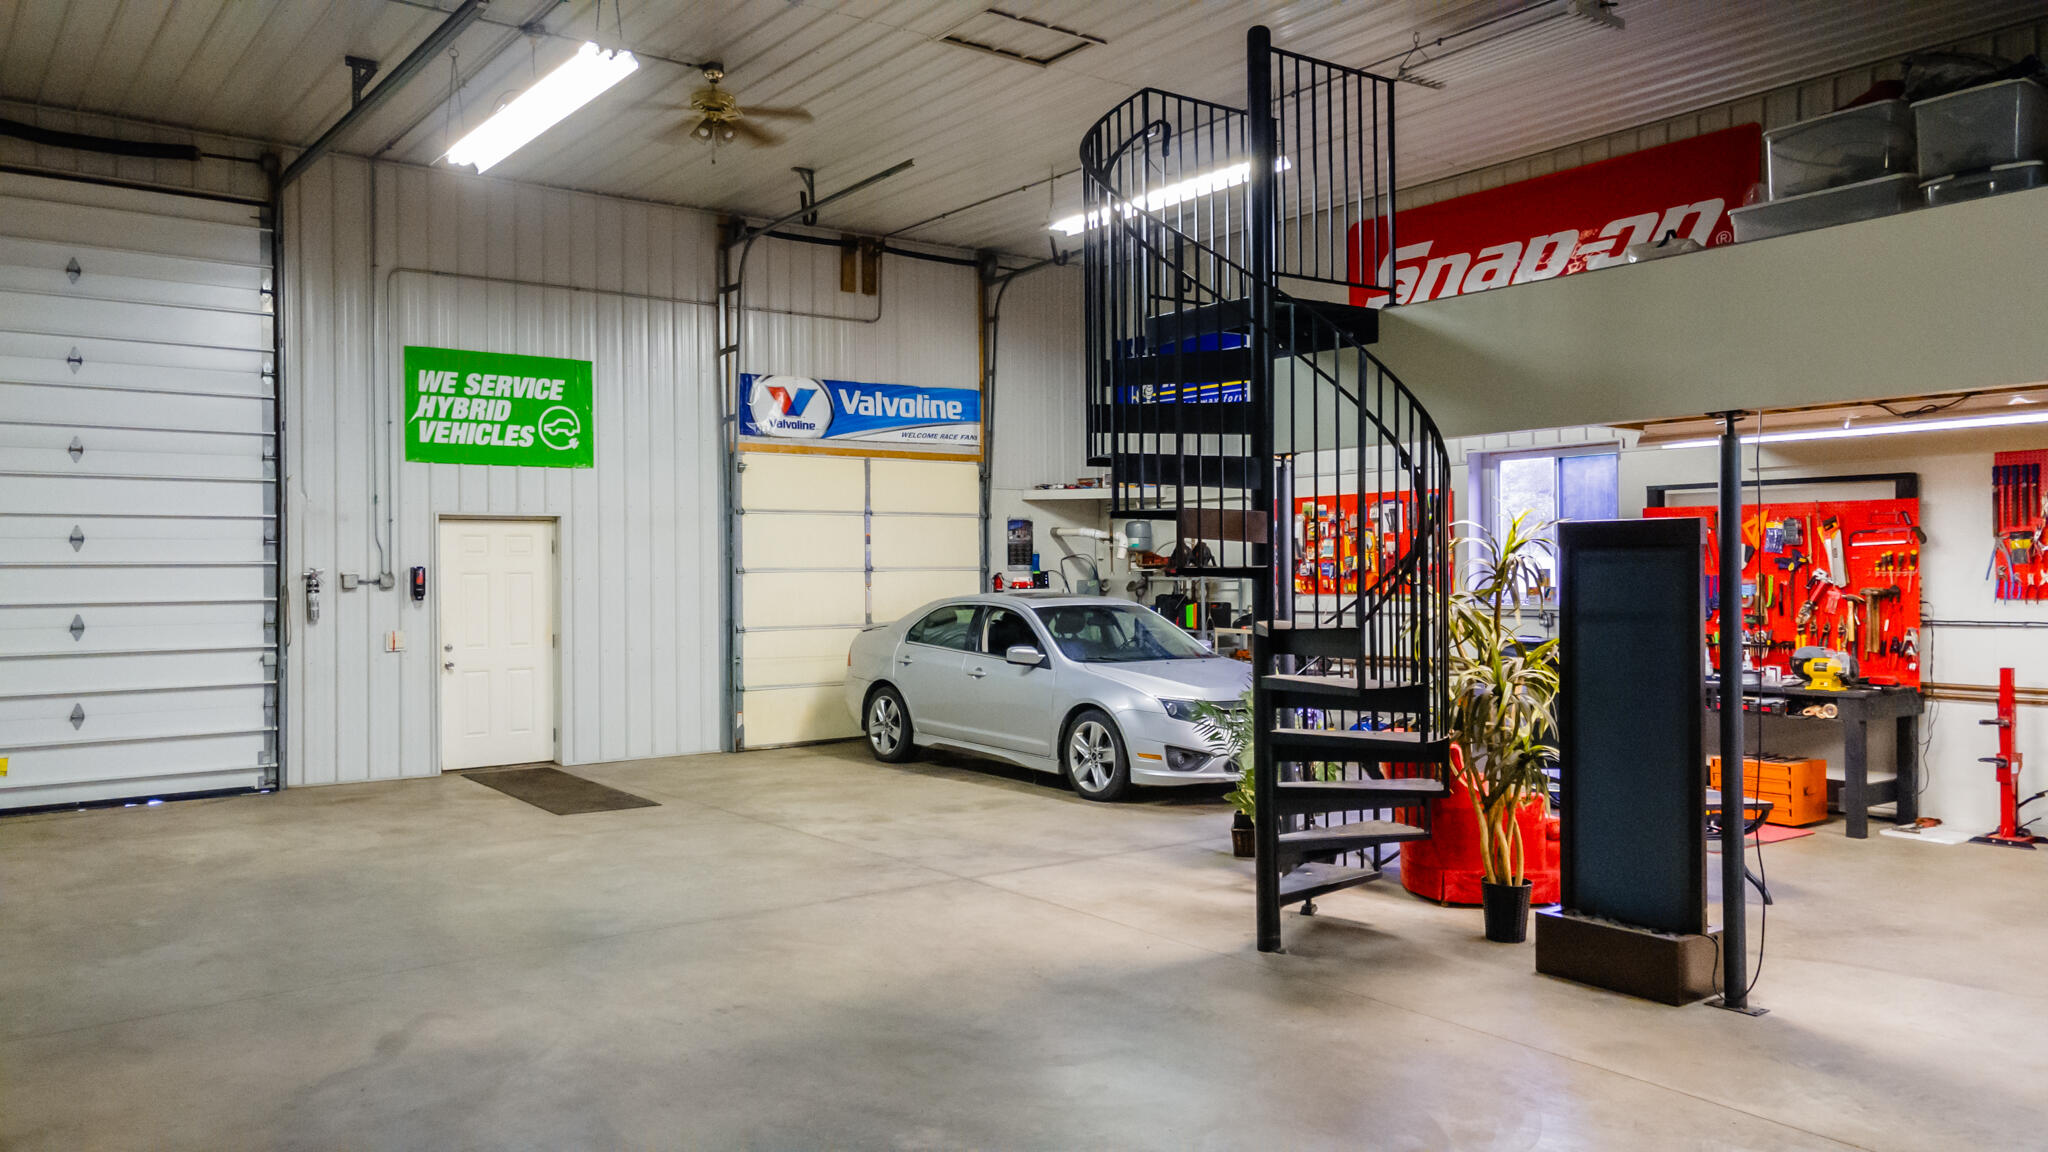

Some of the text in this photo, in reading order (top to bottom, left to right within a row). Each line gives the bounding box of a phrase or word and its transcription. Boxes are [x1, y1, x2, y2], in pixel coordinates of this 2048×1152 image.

[1366, 198, 1725, 310] Snap-on
[418, 369, 566, 401] WE SERVICE
[408, 395, 512, 423] HYBRID
[838, 388, 963, 419] Valvoline
[418, 420, 536, 448] VEHICLES
[768, 418, 816, 431] Valvoline
[901, 431, 938, 440] WELCOME
[939, 433, 958, 441] RACE
